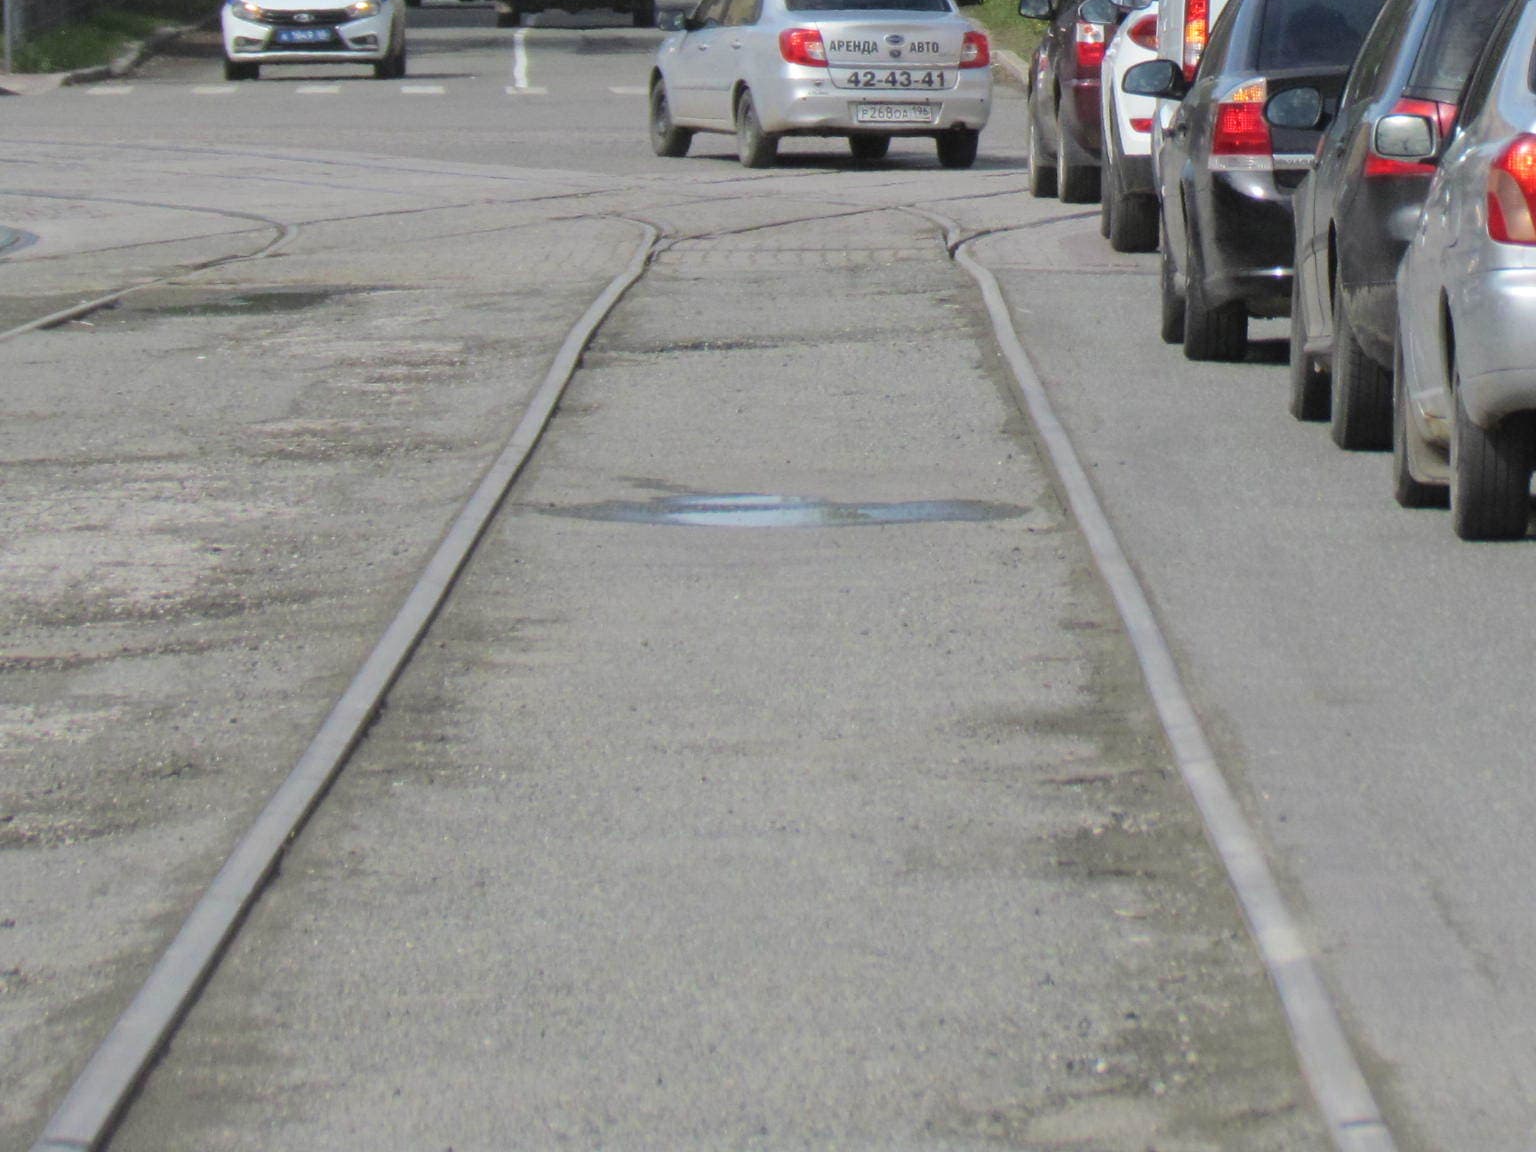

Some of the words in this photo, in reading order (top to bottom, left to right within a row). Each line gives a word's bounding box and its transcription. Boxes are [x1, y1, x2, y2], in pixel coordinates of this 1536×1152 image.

[829, 40, 879, 54] АРЕНДА
[910, 41, 939, 53] АВТО
[847, 71, 945, 87] 42-43-41
